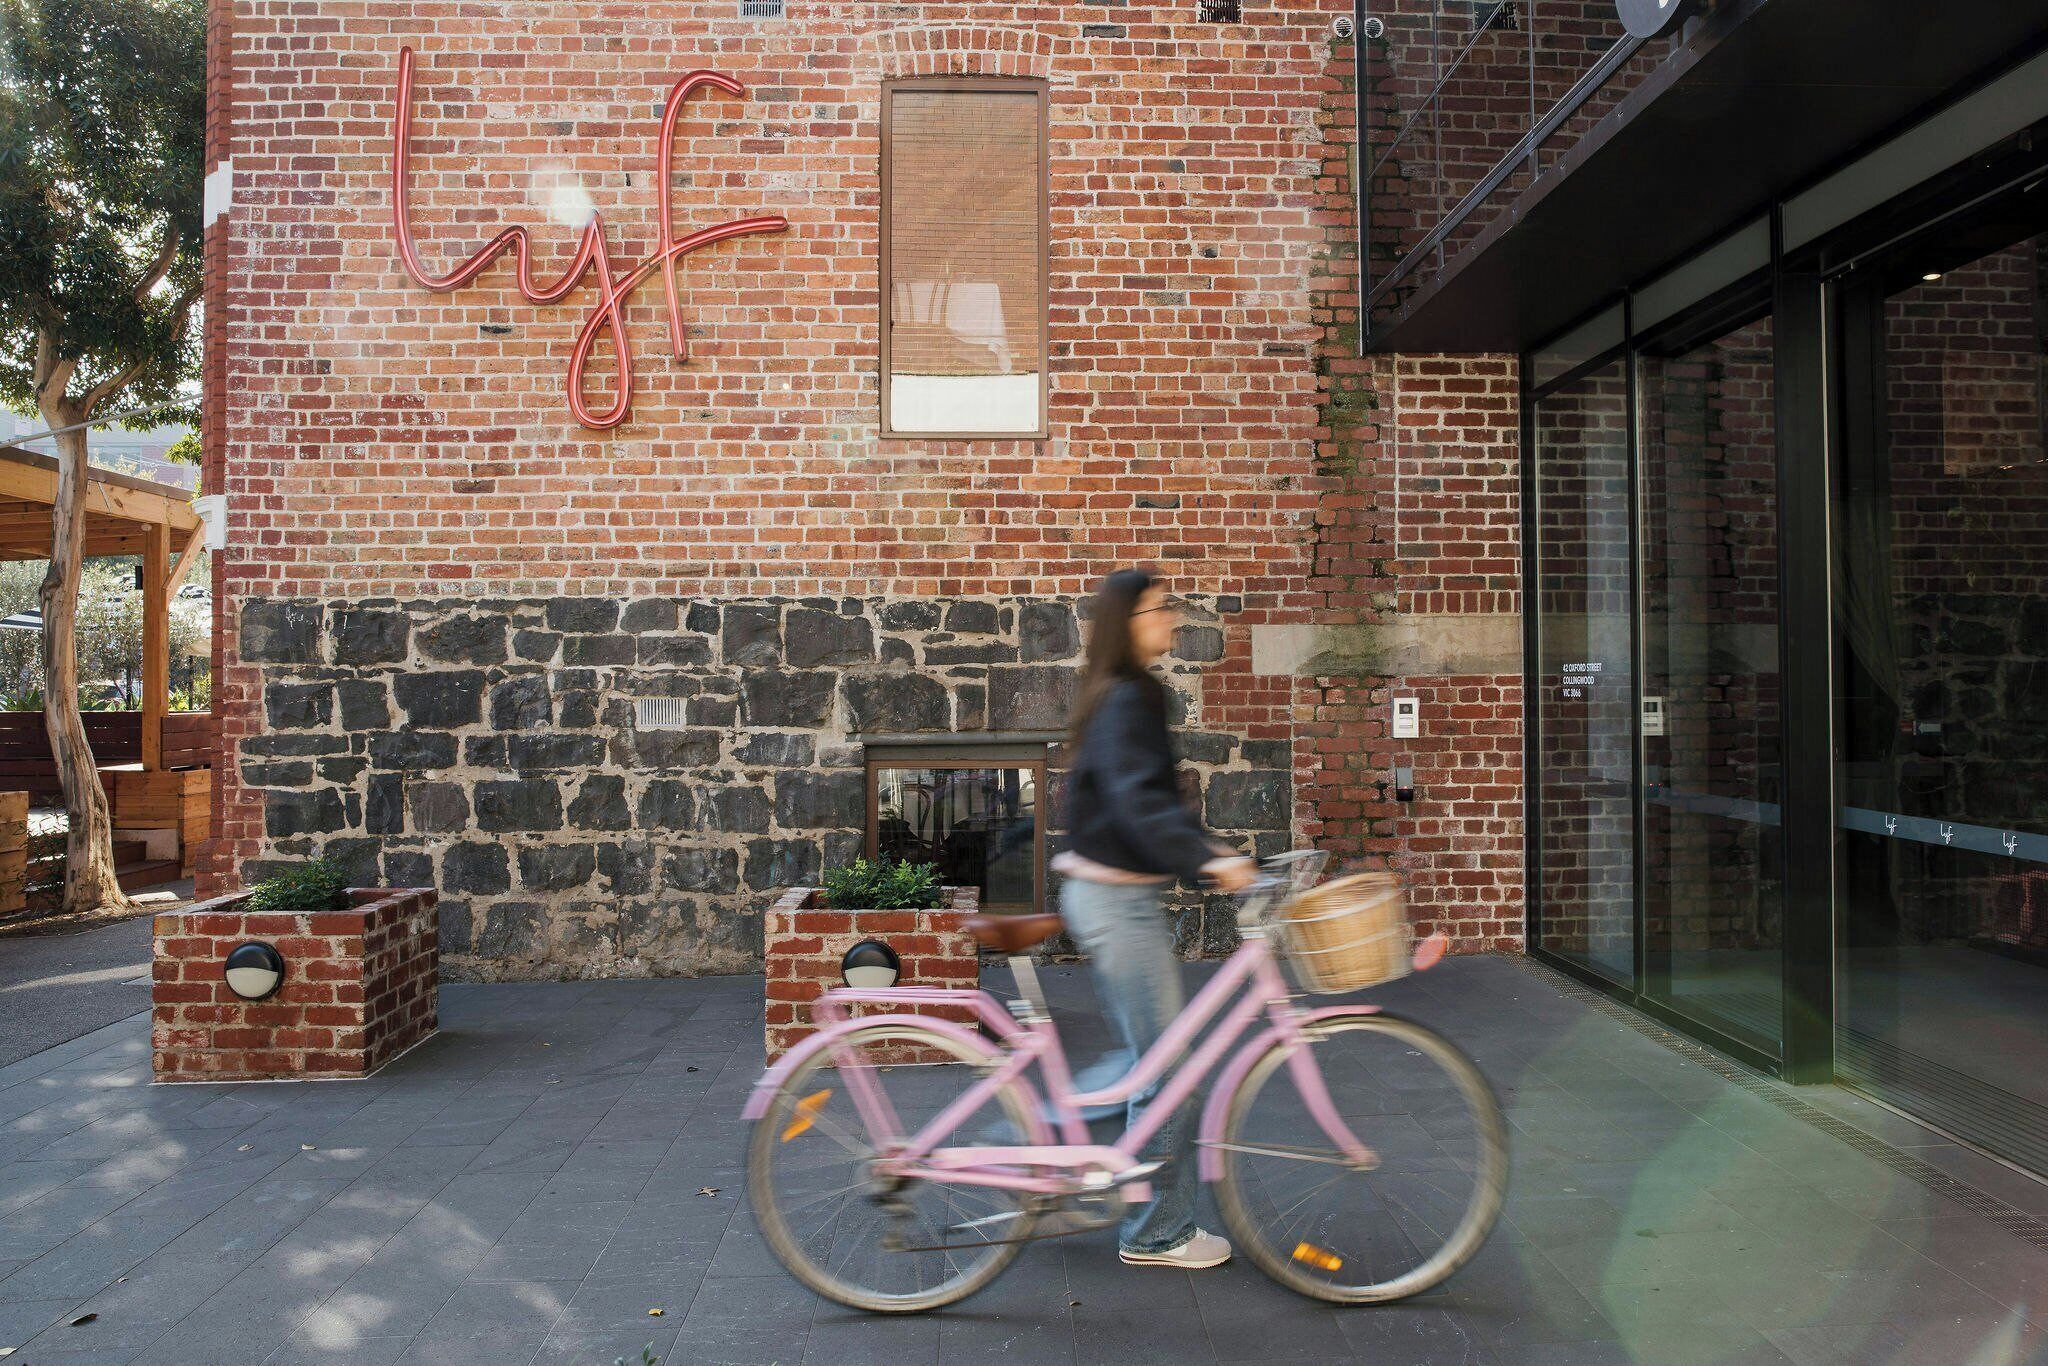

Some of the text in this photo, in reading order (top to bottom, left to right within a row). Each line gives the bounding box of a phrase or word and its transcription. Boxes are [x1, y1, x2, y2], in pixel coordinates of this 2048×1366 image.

[1563, 663, 1602, 672] 42 OXFORD STREET
[1563, 676, 1595, 685] COLLINGWOOD
[1571, 689, 1582, 697] 3066
[1885, 815, 1898, 835] lyf
[1940, 823, 1954, 845] lyf
[2003, 832, 2018, 855] lyf
